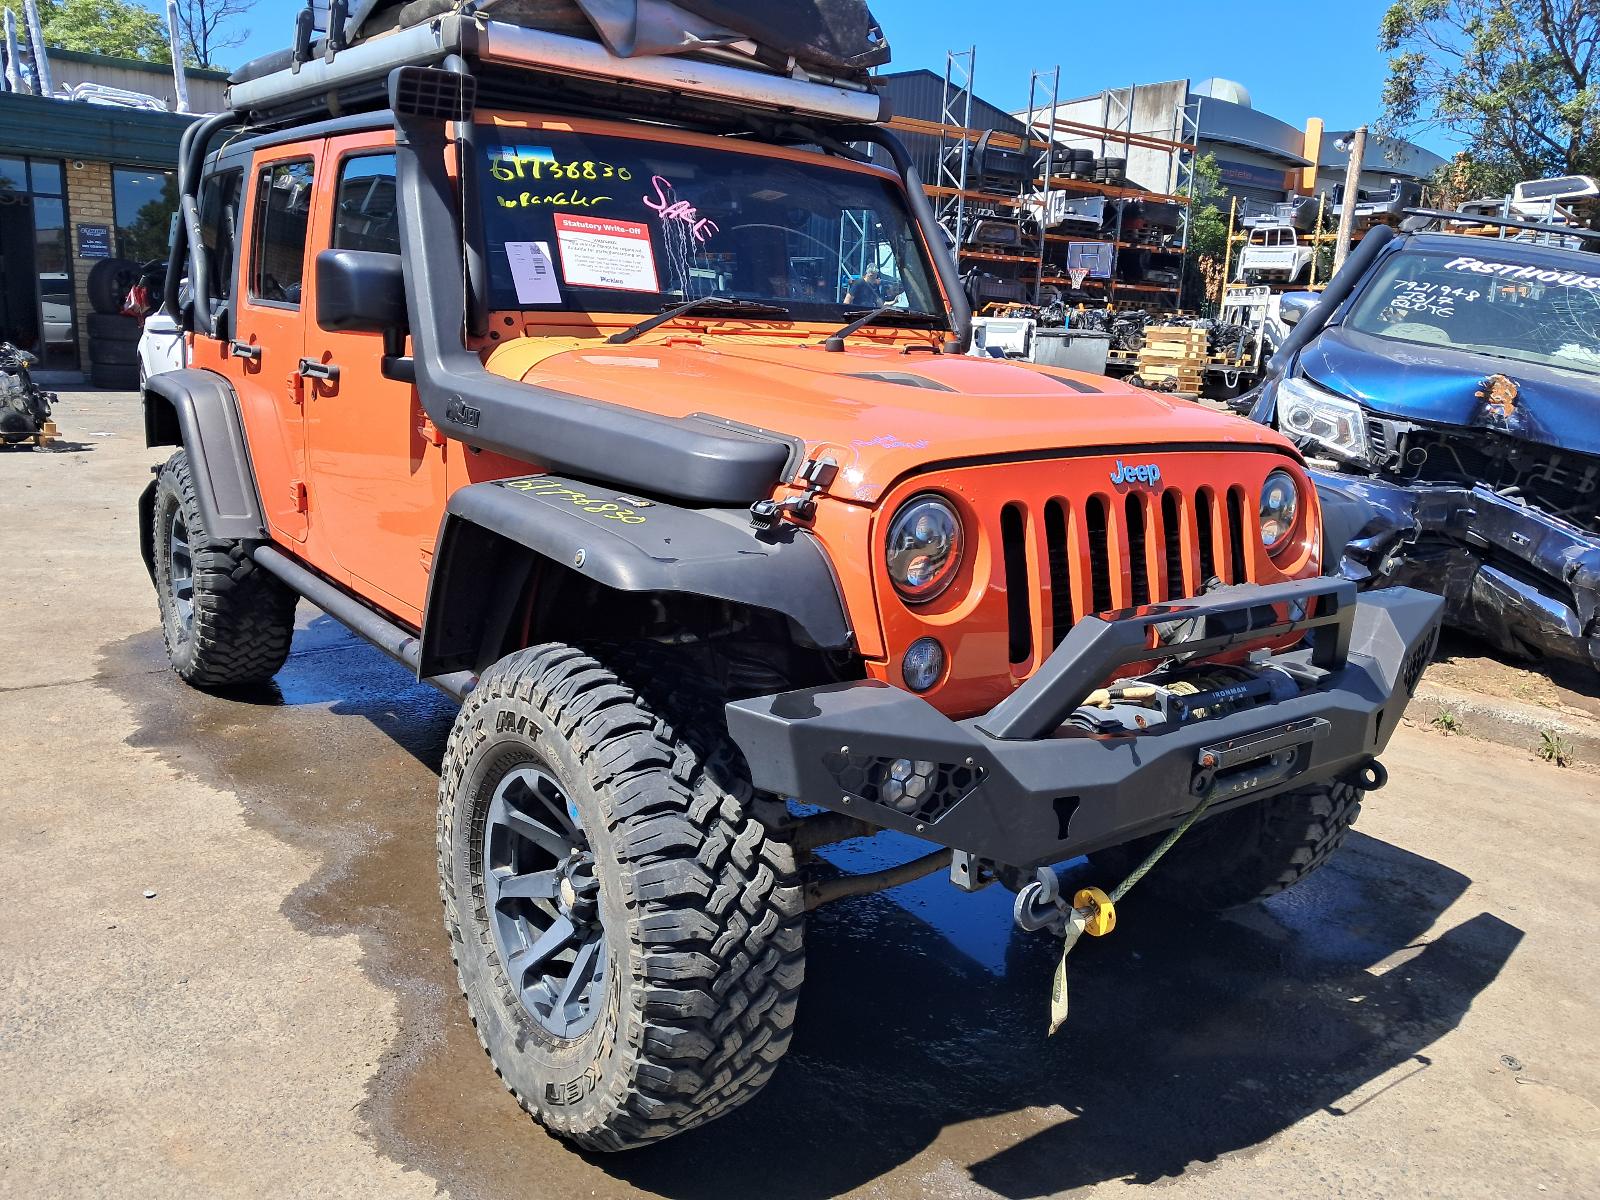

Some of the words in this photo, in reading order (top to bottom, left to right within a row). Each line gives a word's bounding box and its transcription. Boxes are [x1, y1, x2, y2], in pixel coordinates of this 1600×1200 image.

[562, 219, 602, 232] Statutory
[603, 224, 642, 235] Write-Off
[1443, 256, 1600, 290] FASTHOUS
[1110, 459, 1161, 487] Jeep
[1212, 685, 1248, 699] IRONMAN
